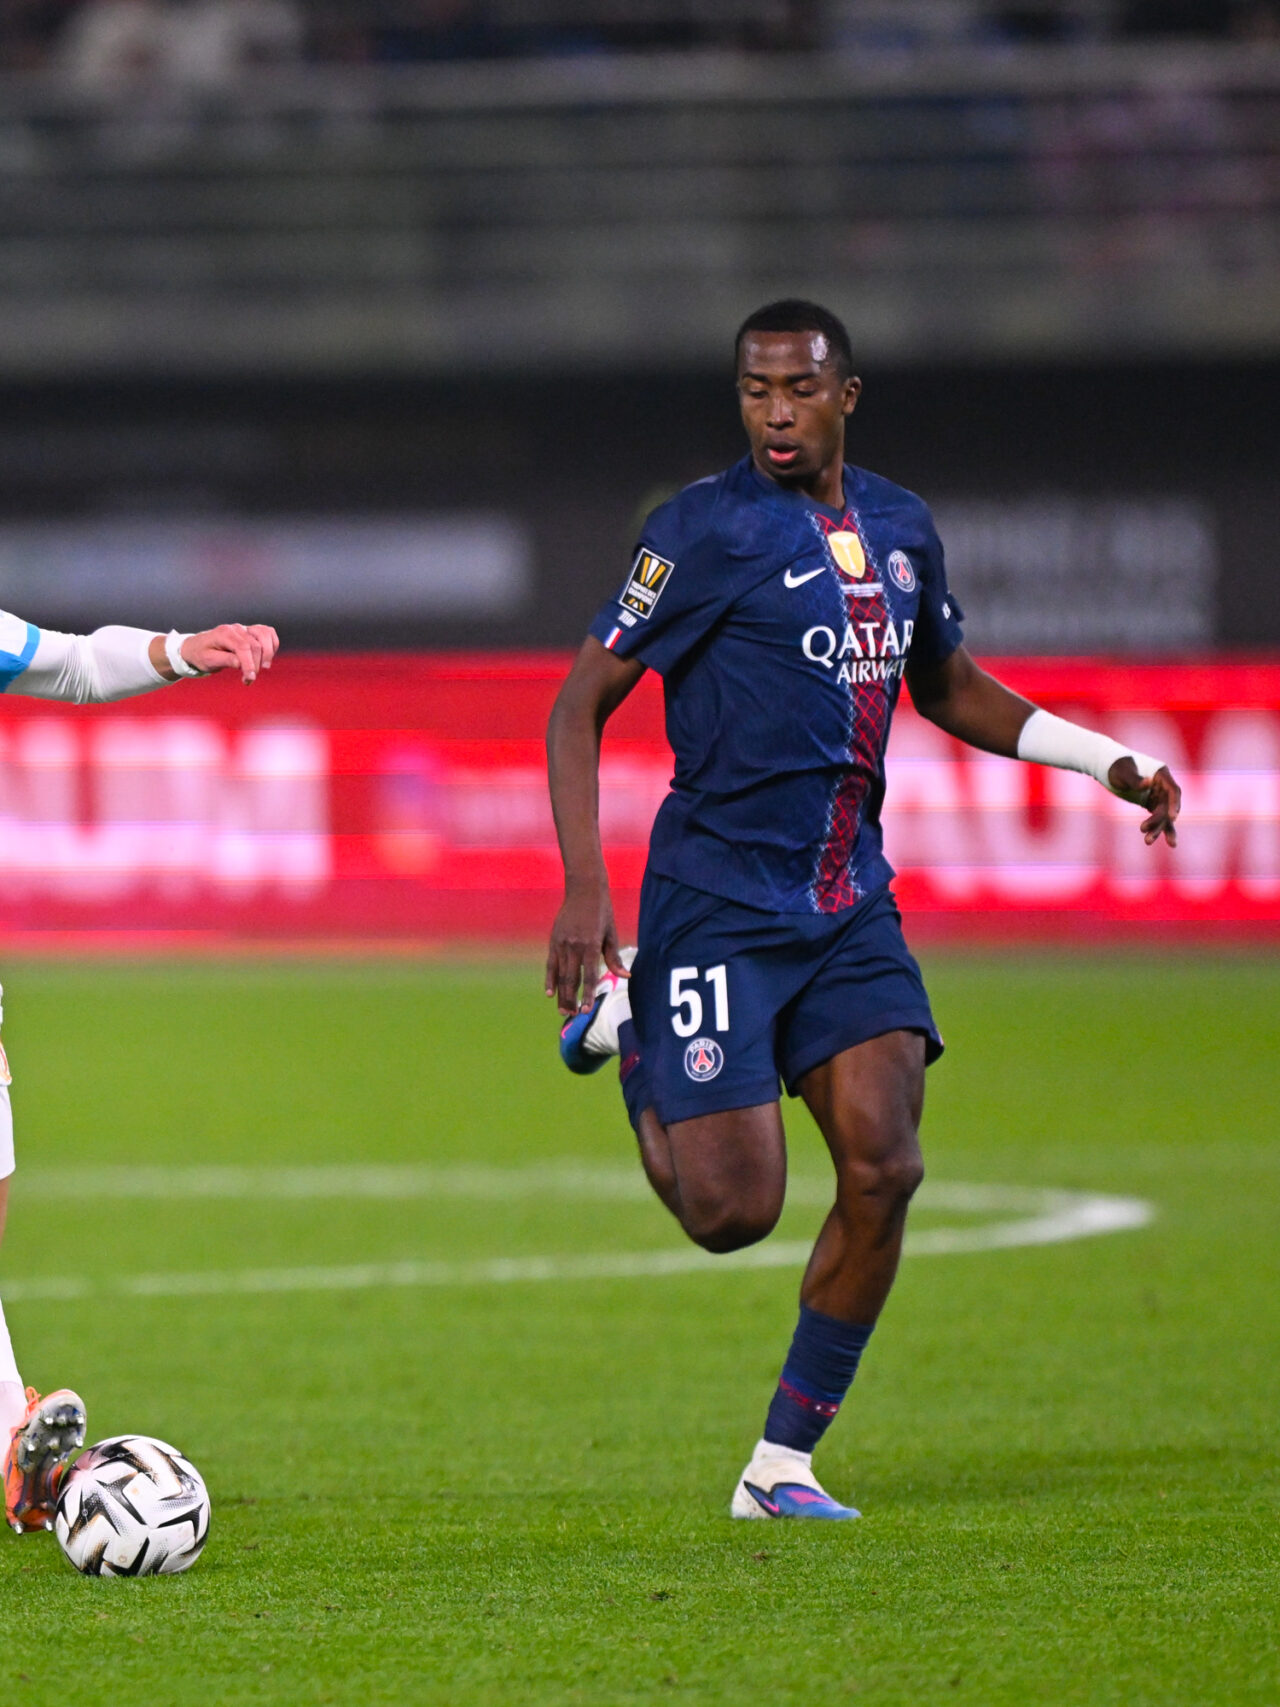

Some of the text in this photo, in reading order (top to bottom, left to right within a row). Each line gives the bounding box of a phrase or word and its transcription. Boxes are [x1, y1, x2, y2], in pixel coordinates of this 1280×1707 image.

[801, 619, 914, 669] QATAR
[837, 658, 908, 686] AIRWAY
[670, 964, 730, 1038] 51
